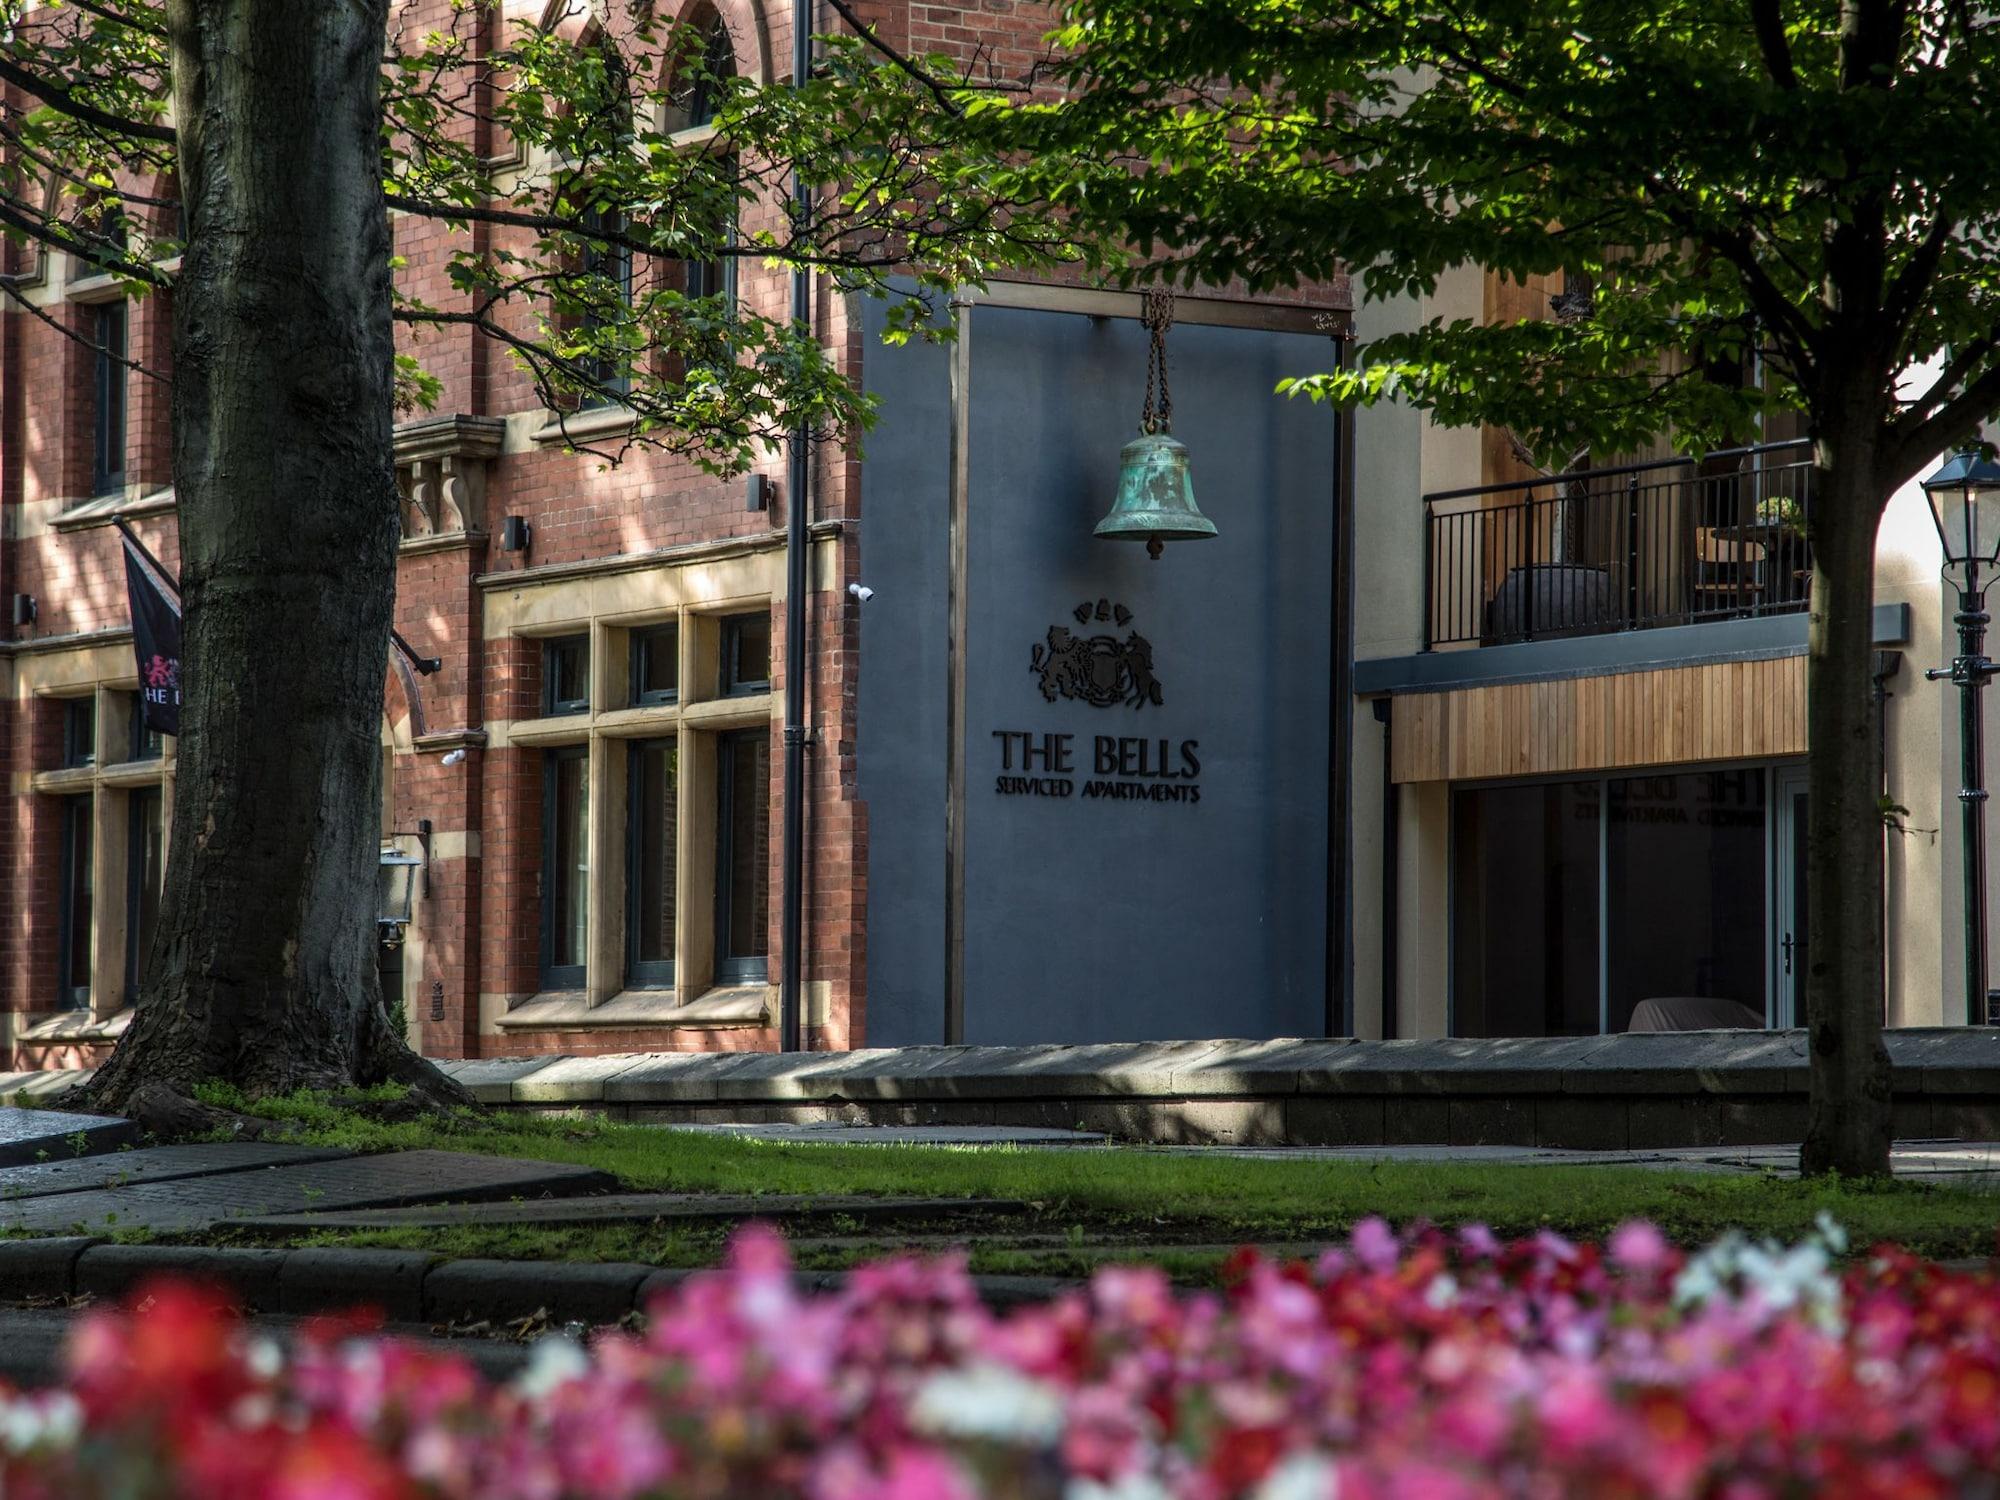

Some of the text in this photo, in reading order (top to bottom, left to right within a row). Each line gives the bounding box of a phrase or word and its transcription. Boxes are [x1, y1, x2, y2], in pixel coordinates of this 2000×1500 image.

[145, 687, 167, 704] HE
[992, 730, 1201, 779] THE BELLS
[995, 776, 1201, 804] SERVICED APARTMENTS
